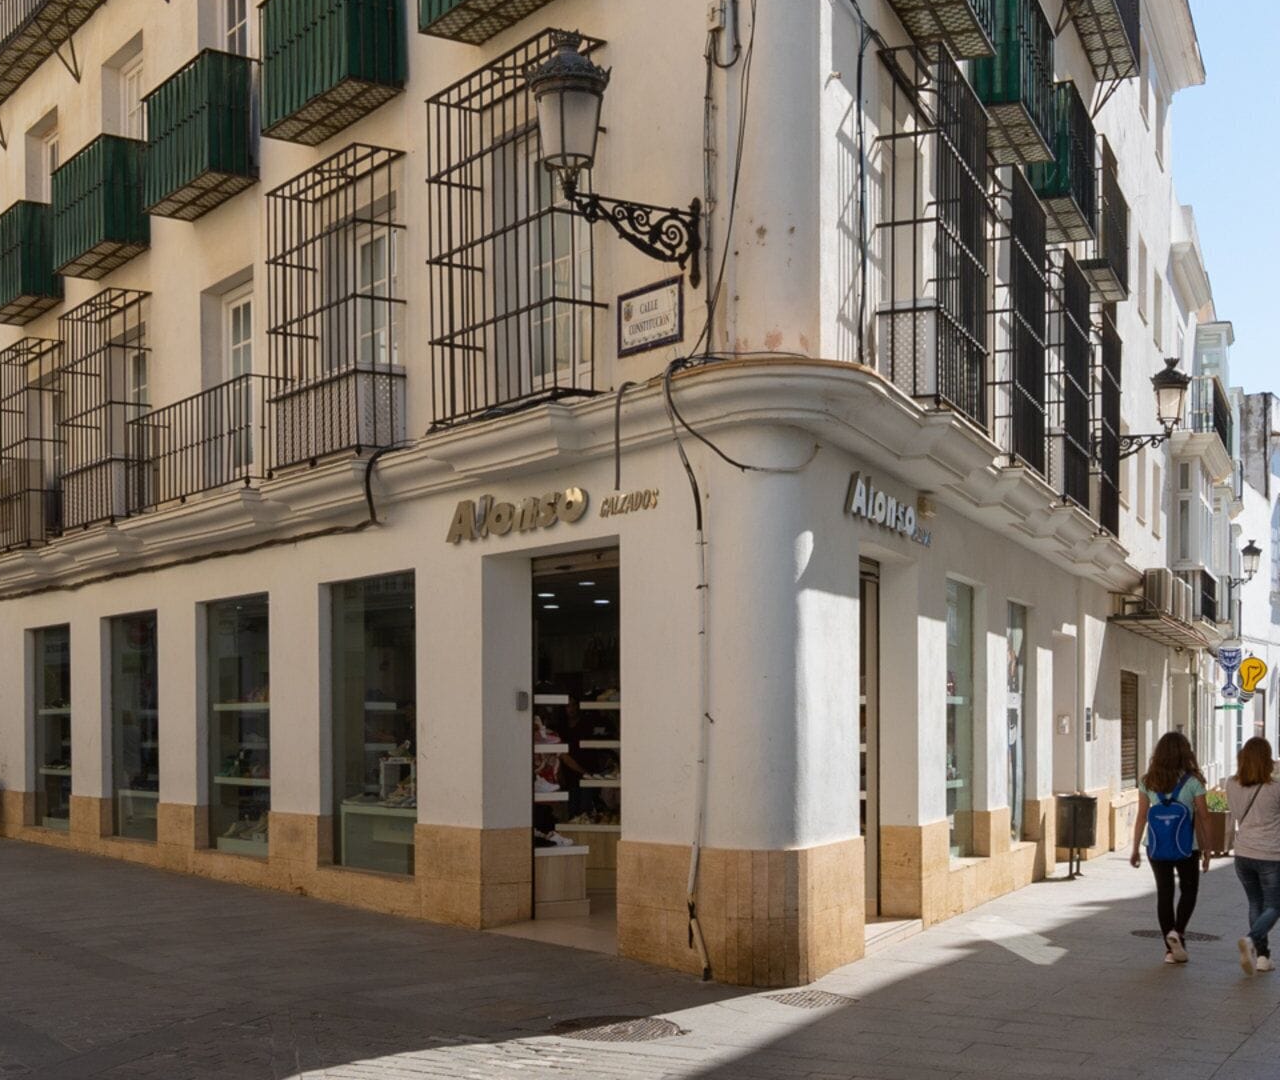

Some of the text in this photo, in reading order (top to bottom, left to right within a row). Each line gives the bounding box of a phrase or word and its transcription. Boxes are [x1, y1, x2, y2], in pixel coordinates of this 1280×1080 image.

[639, 299, 658, 314] CALLE
[445, 486, 659, 545] Alonso CALZADOS
[848, 475, 916, 536] Alonso
